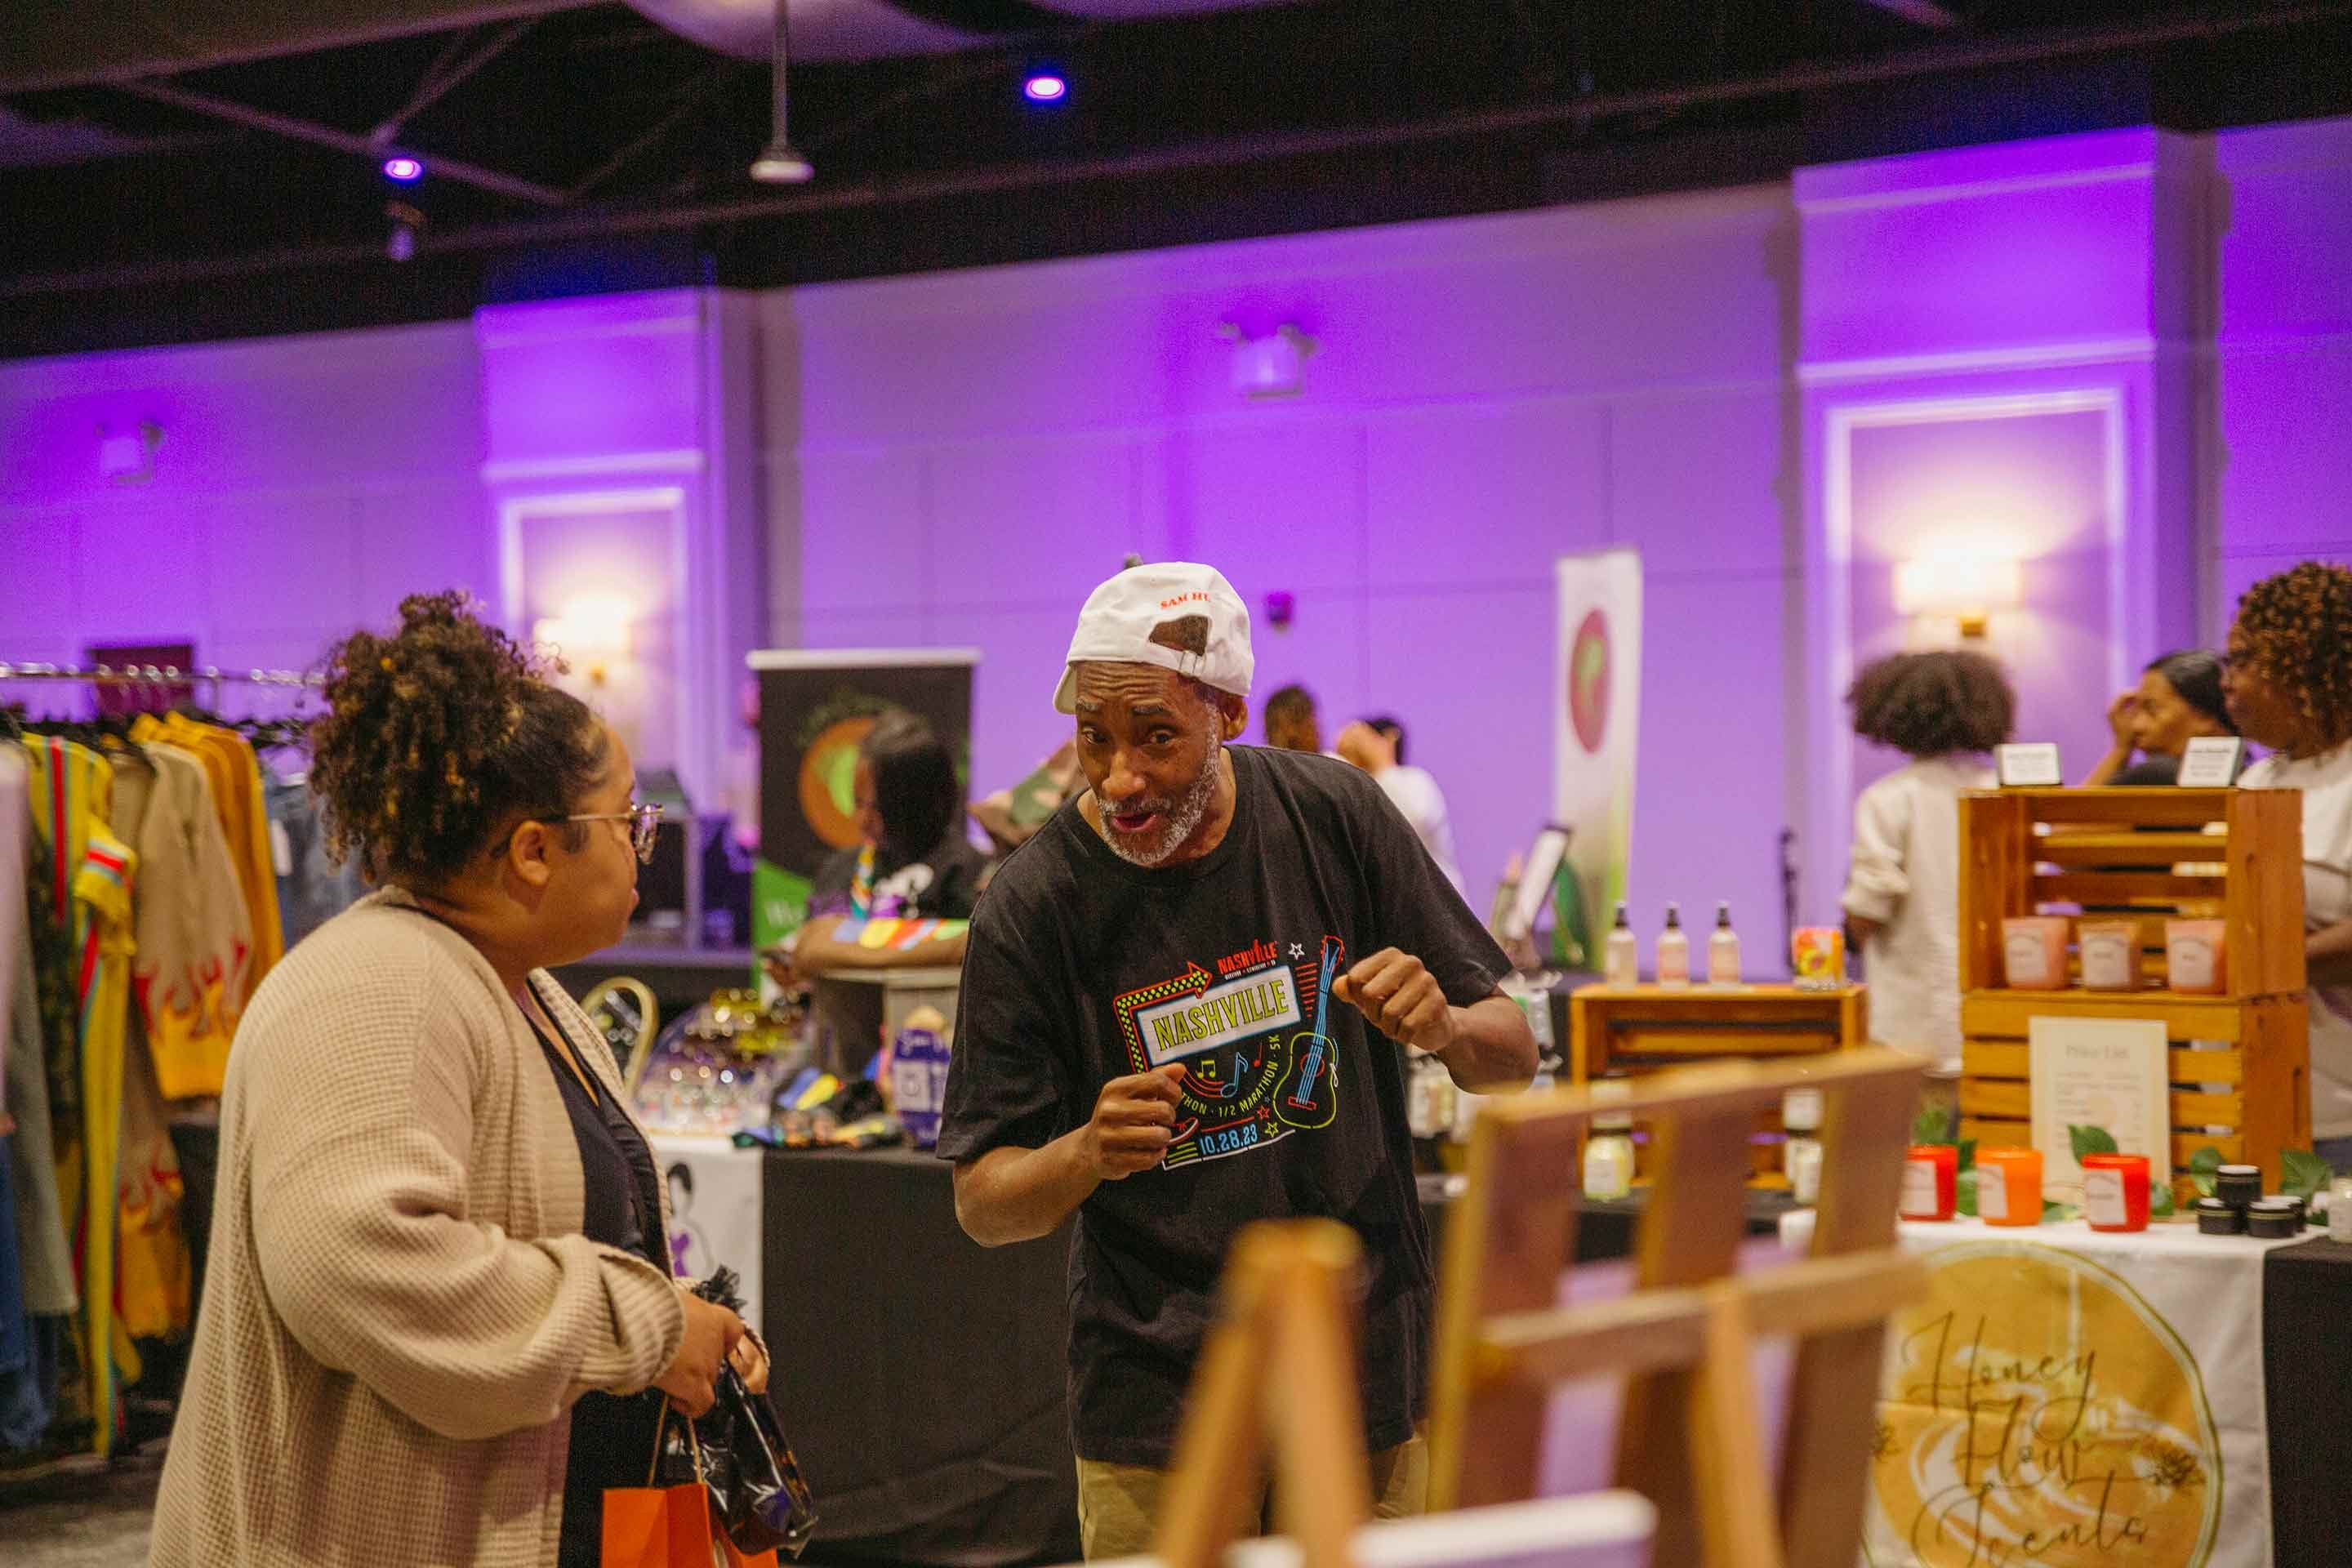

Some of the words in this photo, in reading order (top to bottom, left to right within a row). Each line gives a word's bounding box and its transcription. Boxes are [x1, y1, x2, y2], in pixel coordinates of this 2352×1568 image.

[1160, 593, 1188, 610] SAM
[1217, 938, 1278, 975] NASHVILLE
[1152, 979, 1290, 1052] NASHVILLE
[1183, 1091, 1208, 1116] THON
[1218, 1104, 1237, 1118] 1/2
[1238, 1060, 1280, 1112] MARATHON
[1268, 1033, 1281, 1051] 5K
[1200, 1123, 1258, 1155] 10.28.23
[1900, 1309, 2096, 1444] Honey
